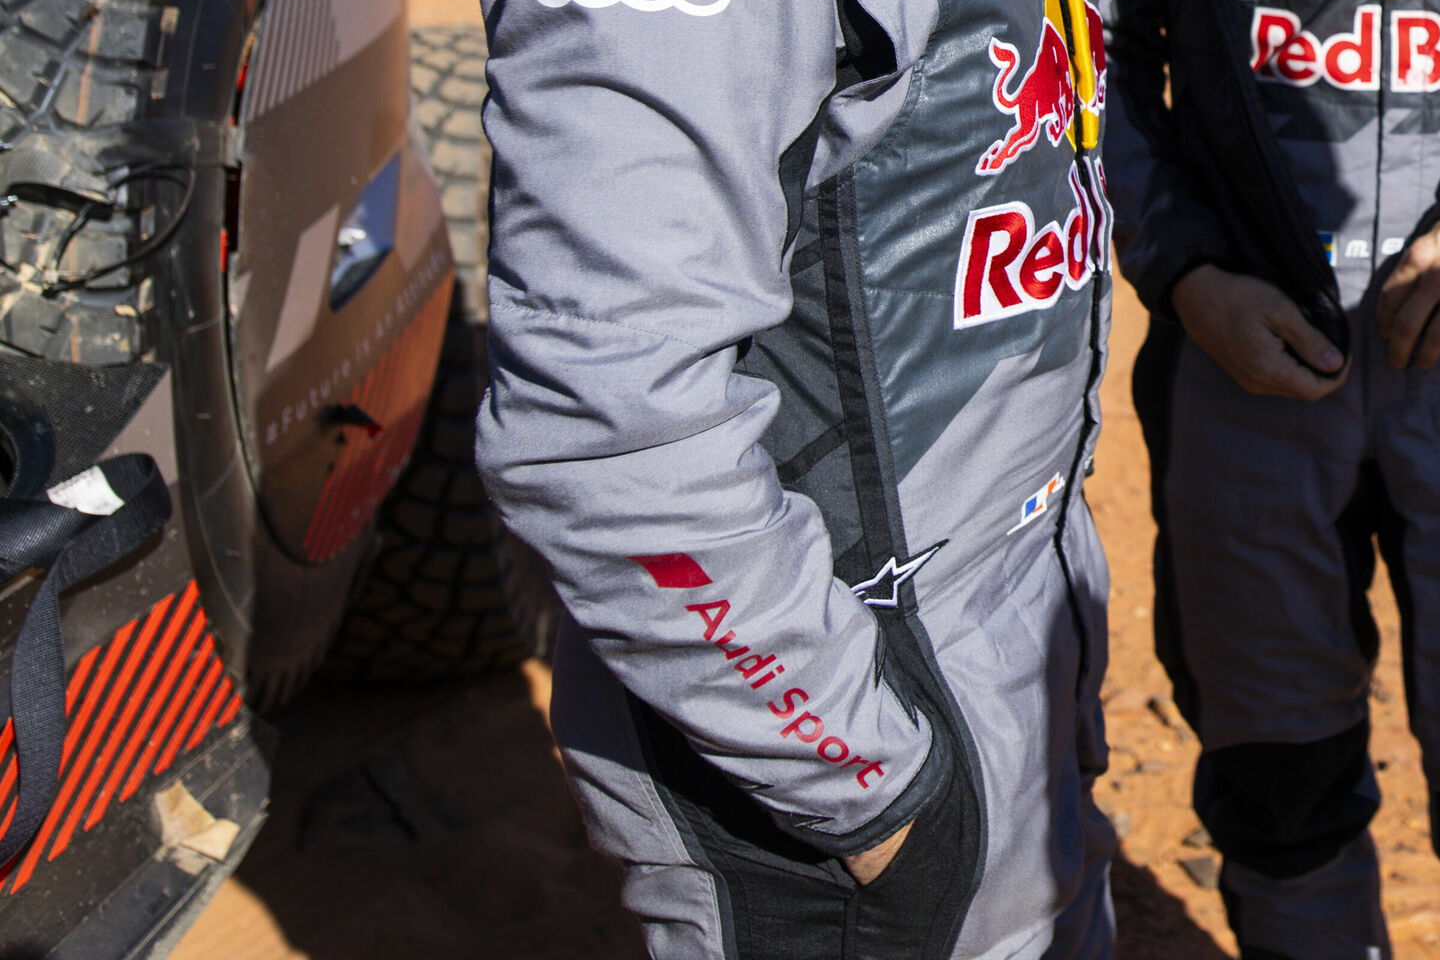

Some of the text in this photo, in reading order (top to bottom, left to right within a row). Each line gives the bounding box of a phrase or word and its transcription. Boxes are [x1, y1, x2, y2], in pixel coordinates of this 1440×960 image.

[1250, 4, 1382, 91] Red
[954, 159, 1096, 330] Red
[684, 599, 885, 790] Audi Sport
